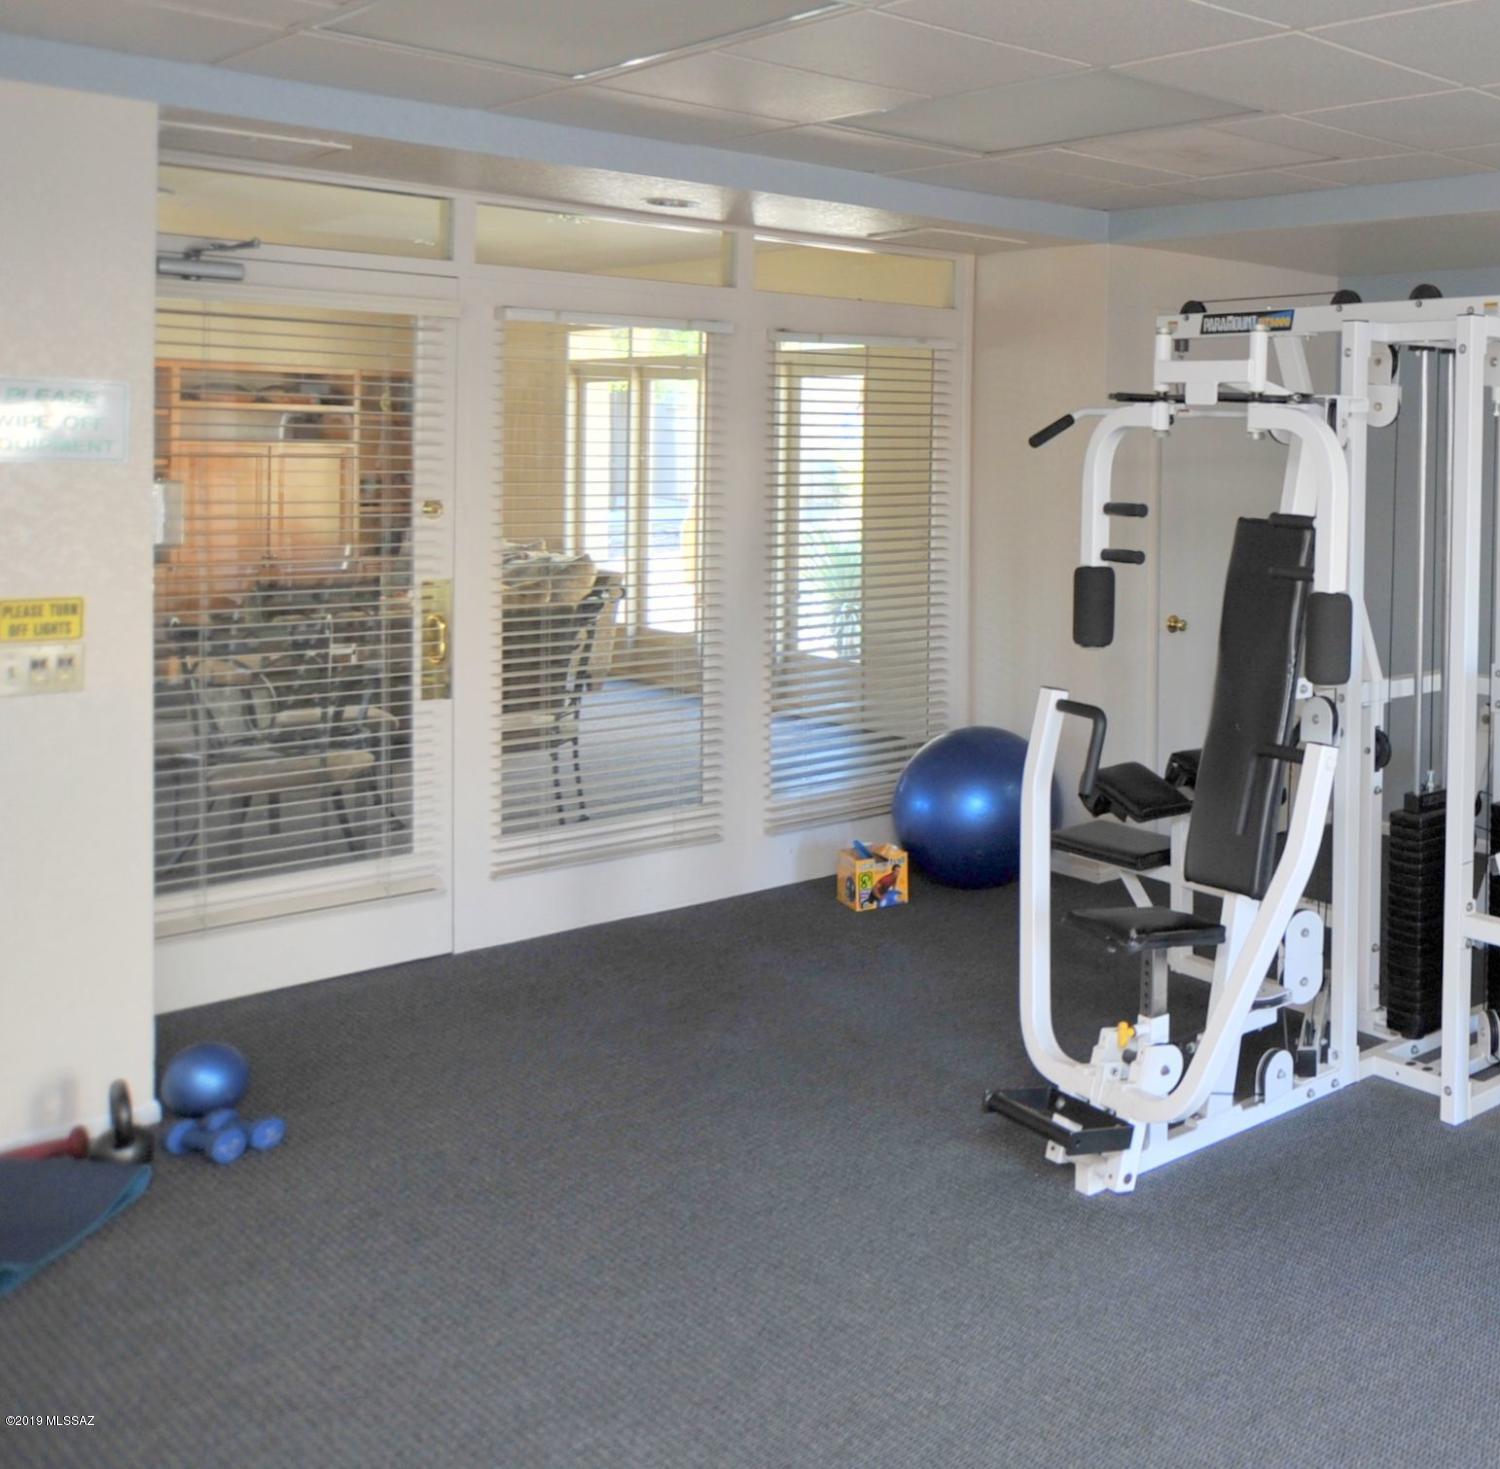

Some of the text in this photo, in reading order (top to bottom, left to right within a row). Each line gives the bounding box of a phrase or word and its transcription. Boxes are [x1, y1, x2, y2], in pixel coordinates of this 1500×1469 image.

[2, 603, 78, 619] PLEASE TURN
[9, 622, 71, 636] OFF LIGHTS
